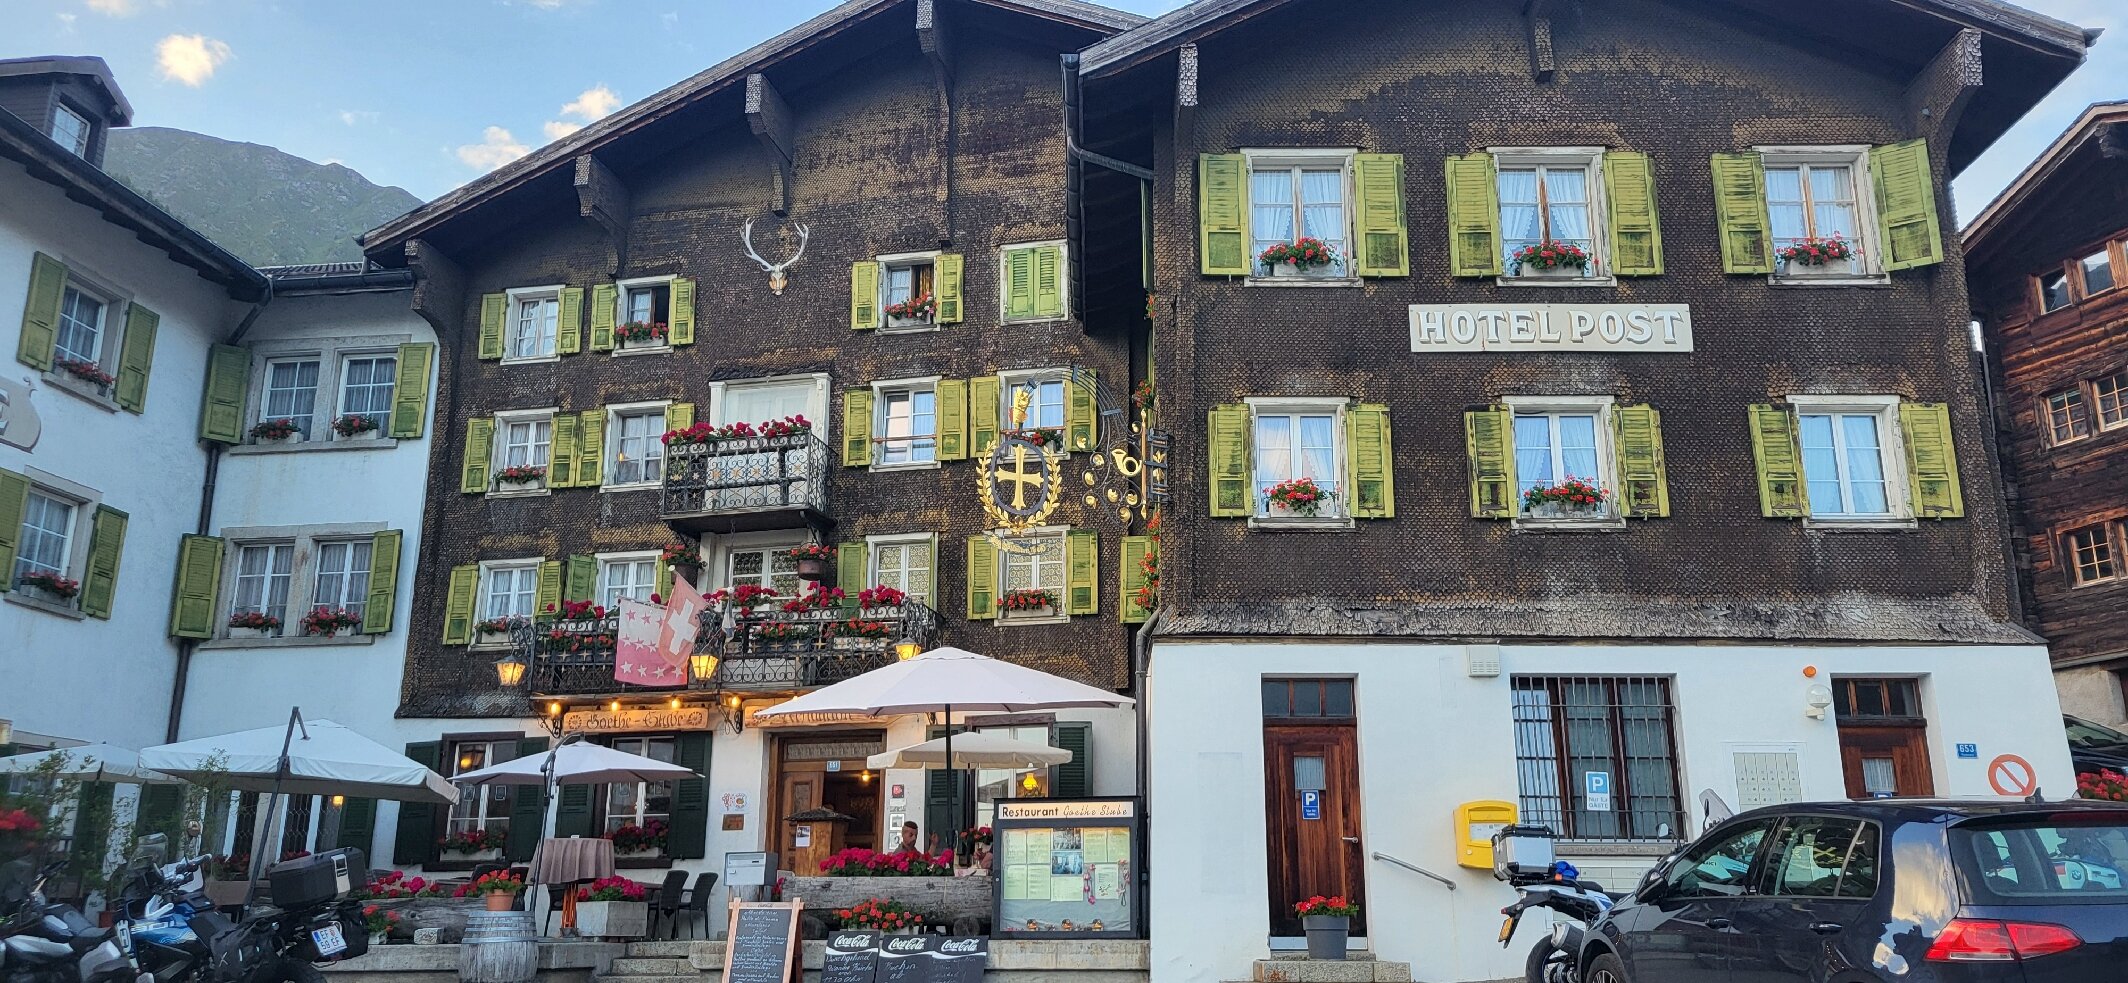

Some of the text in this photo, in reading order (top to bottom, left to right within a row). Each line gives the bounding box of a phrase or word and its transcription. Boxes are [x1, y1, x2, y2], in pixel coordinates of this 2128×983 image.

[1417, 309, 1684, 344] HOTEL POST
[1959, 744, 1975, 753] 653
[1591, 776, 1604, 792] P
[1305, 792, 1316, 806] P
[1002, 806, 1059, 818] Restaurant
[1099, 803, 1128, 816] Stube
